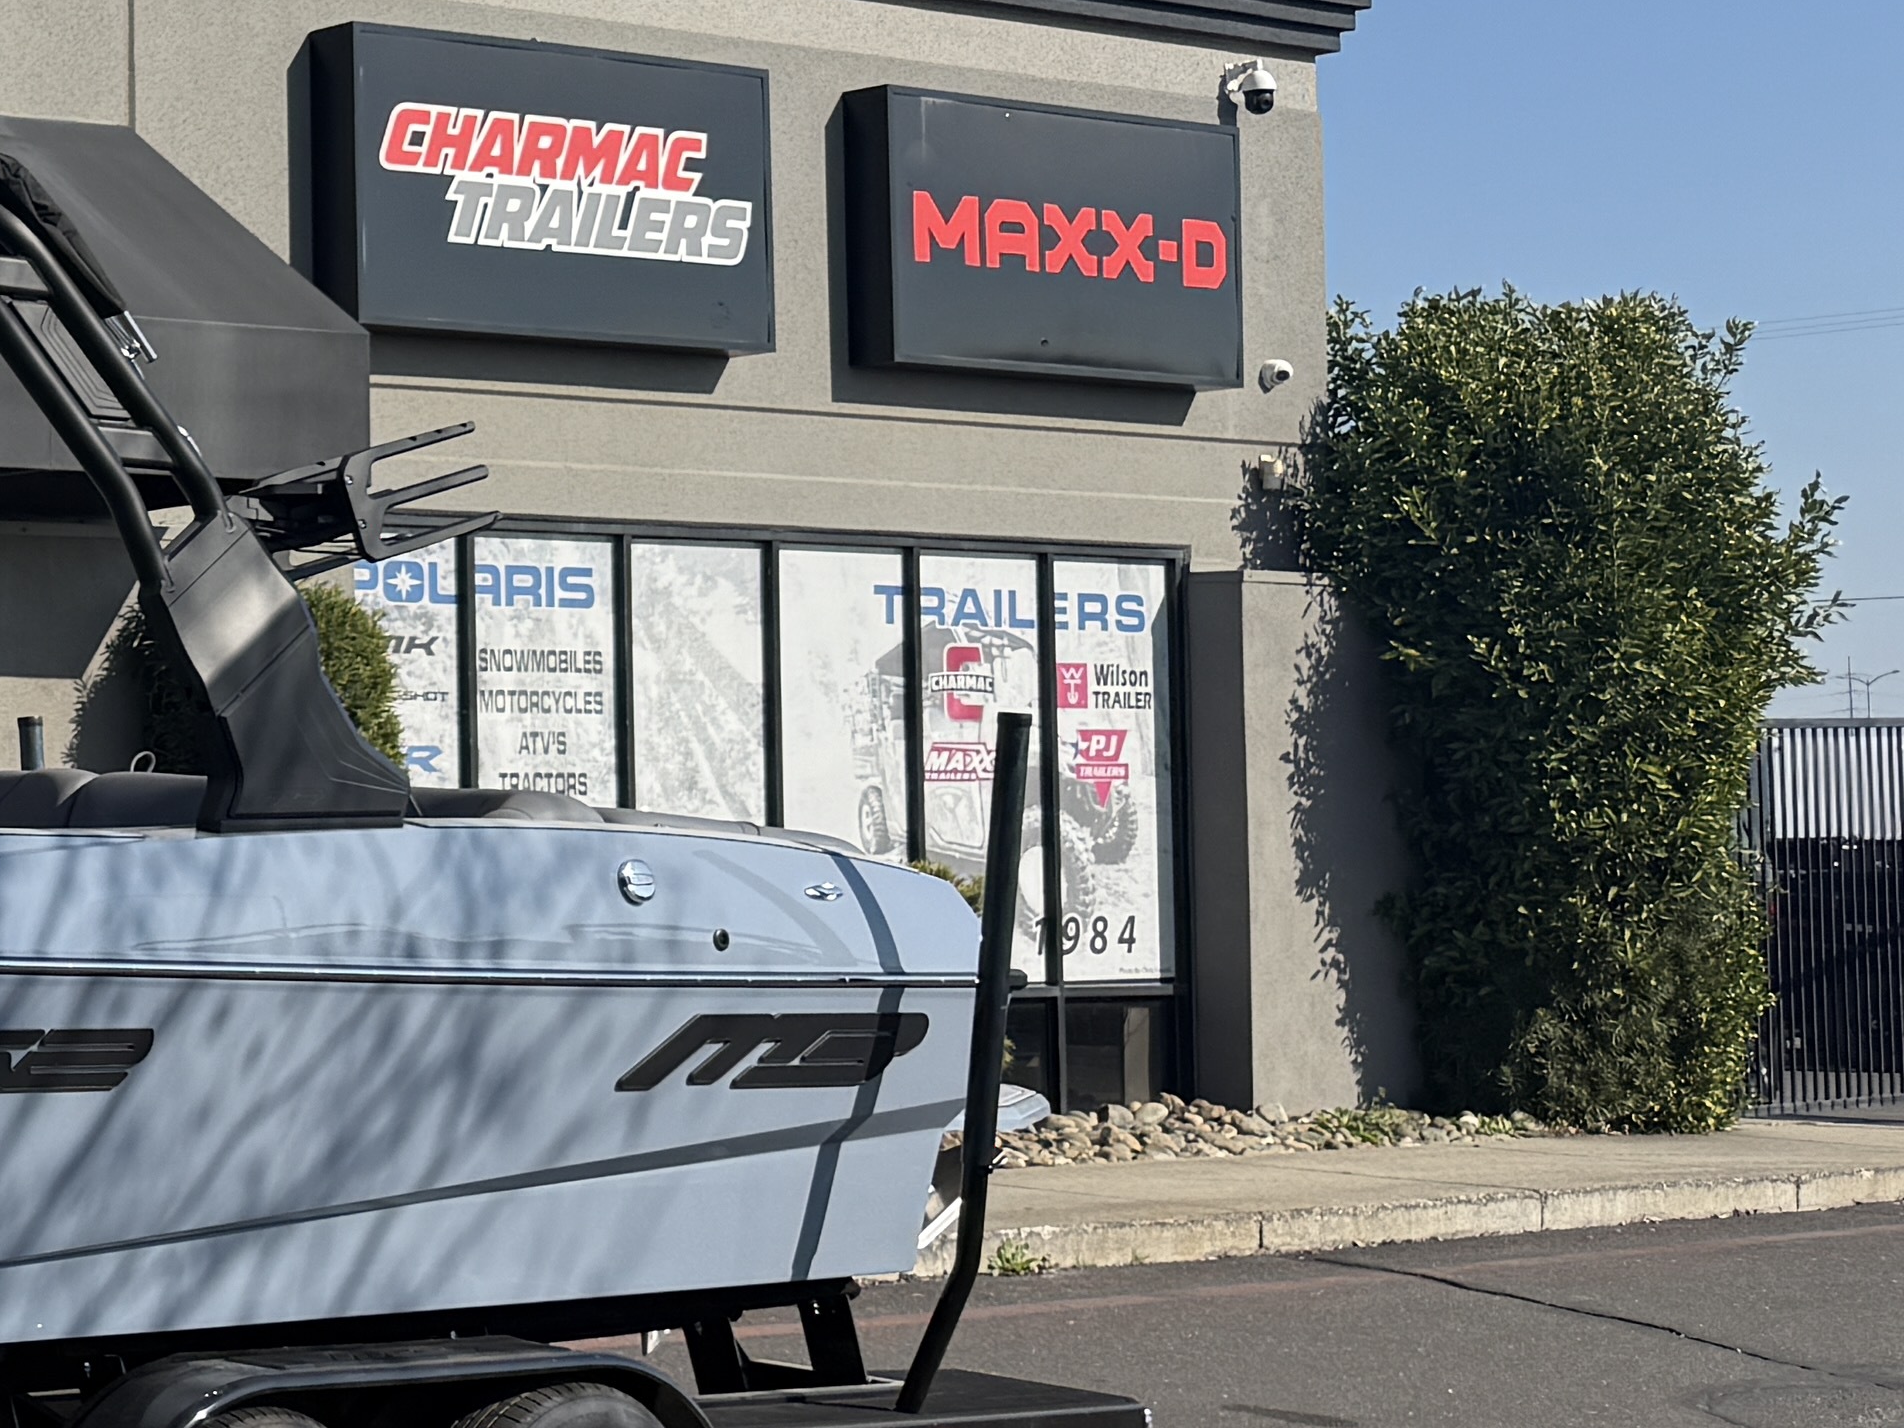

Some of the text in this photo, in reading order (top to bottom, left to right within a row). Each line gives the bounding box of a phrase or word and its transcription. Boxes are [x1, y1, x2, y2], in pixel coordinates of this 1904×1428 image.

[379, 102, 708, 197] CHARMAC
[444, 174, 753, 266] TRAILERS
[912, 189, 1227, 288] MAXX-D
[873, 583, 1146, 634] TRAILERS
[478, 647, 604, 674] SNOWMOBILES
[930, 674, 993, 692] CHARMAC
[1094, 663, 1149, 687] Wilson
[479, 689, 604, 715] MOTORCYCLES
[1092, 691, 1153, 710] TRAILER
[518, 730, 567, 755] ATV'S
[1089, 734, 1119, 757] PJ
[499, 771, 588, 796] TRACTORS
[1079, 766, 1126, 778] TRAILERS
[1034, 914, 1137, 957] 1984
